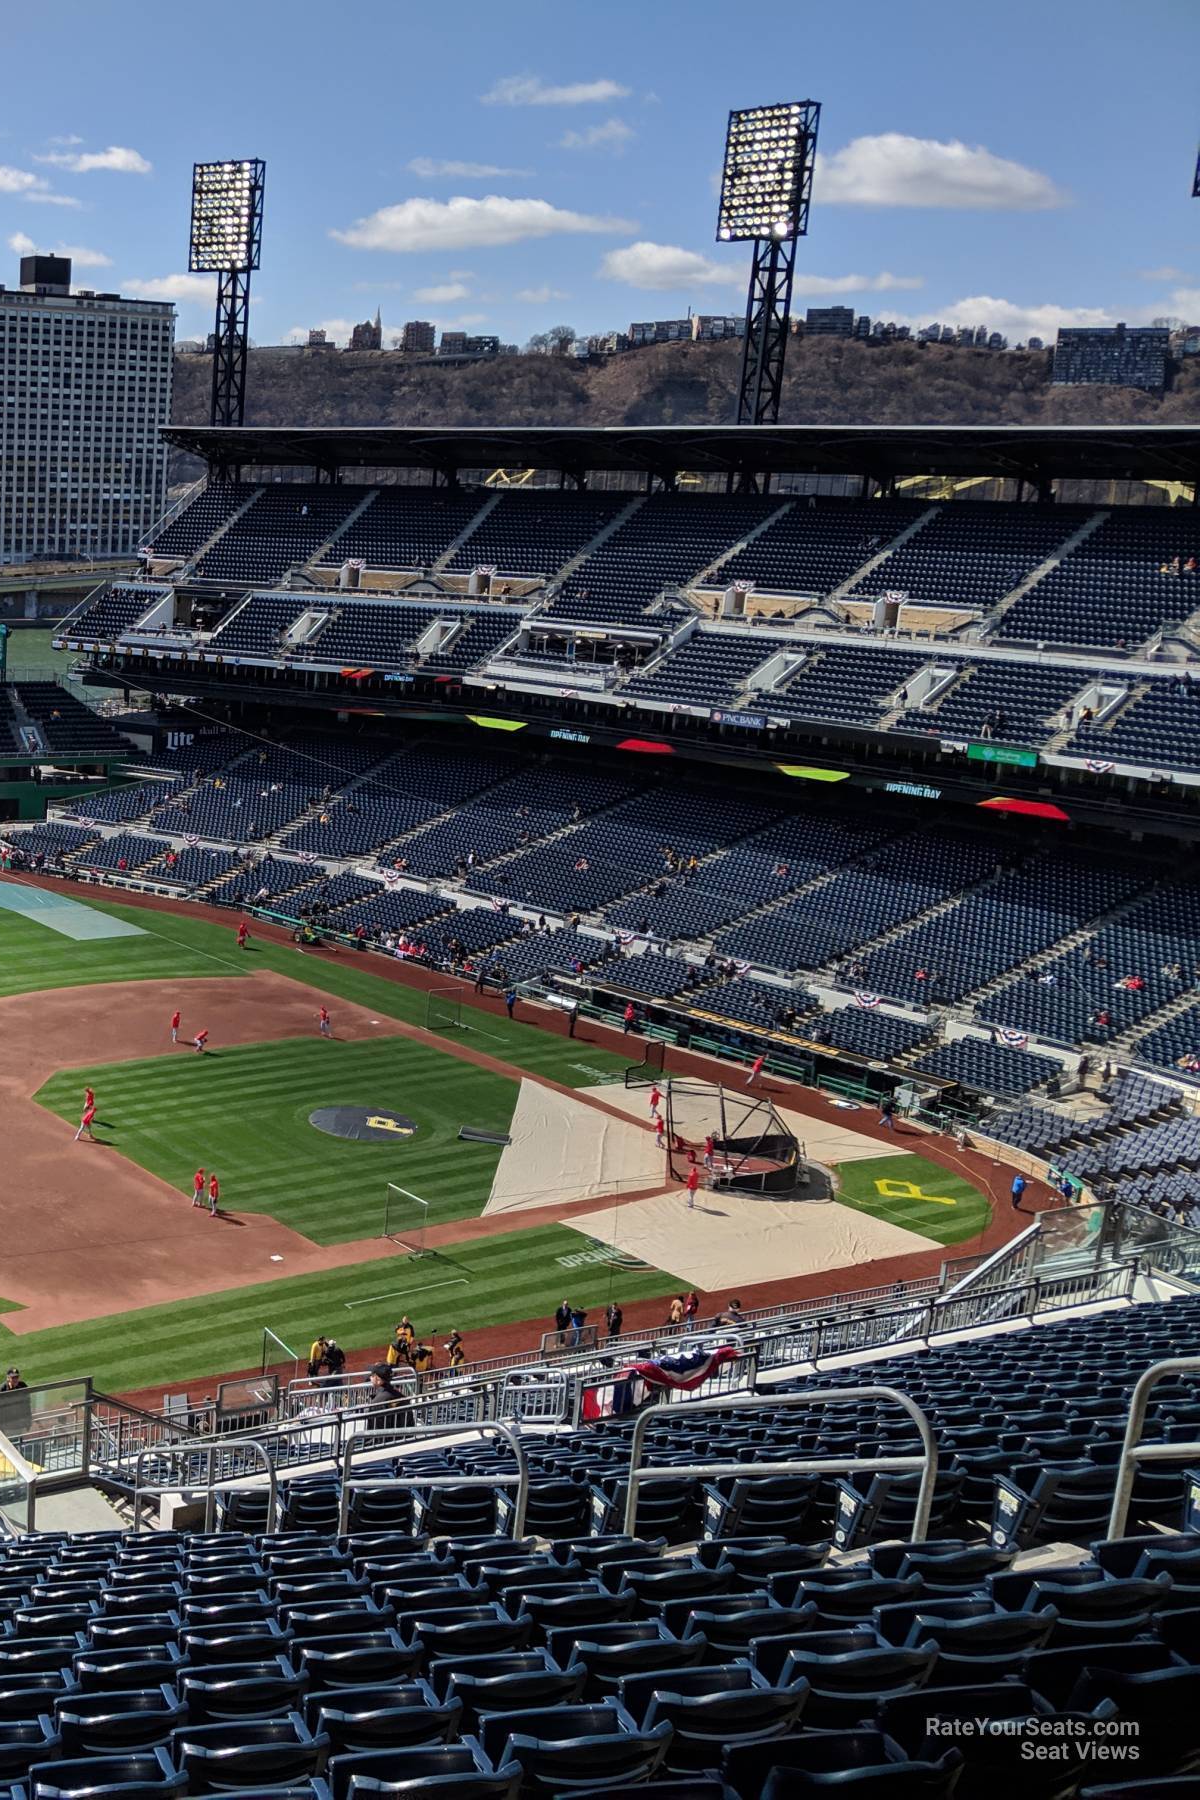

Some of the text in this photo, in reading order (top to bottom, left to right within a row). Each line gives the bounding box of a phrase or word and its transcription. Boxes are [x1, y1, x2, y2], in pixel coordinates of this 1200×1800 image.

[722, 713, 762, 726] PNC BANK
[166, 732, 194, 750] Lite
[550, 730, 577, 741] OPENING
[577, 734, 590, 743] DAY
[885, 783, 923, 796] OPENING
[923, 788, 942, 800] DAY
